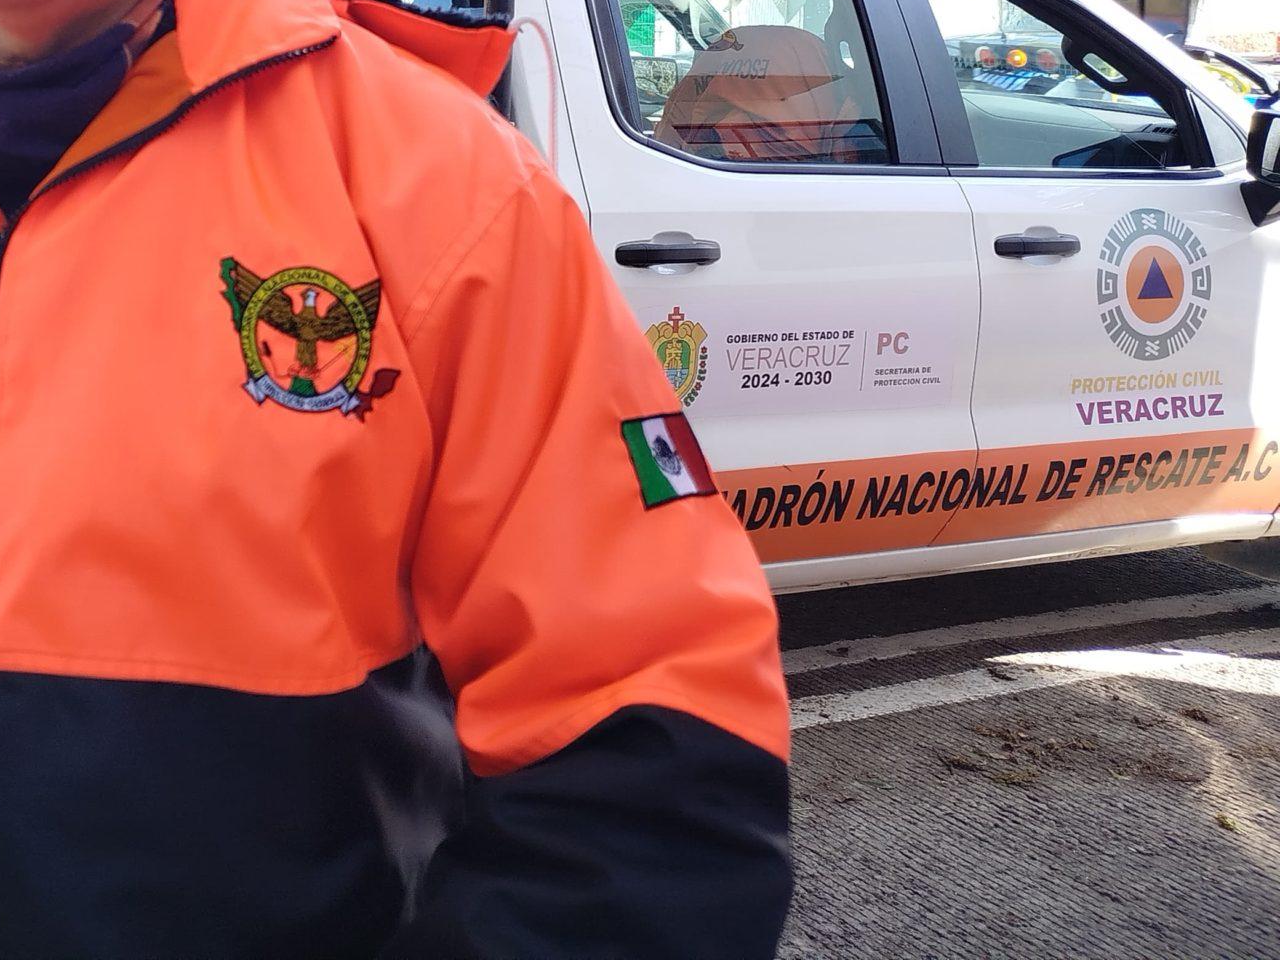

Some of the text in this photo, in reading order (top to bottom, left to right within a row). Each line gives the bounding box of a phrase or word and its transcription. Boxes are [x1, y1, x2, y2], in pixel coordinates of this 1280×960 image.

[726, 329, 855, 344] GOBIERNO DEL ESTADO DE
[876, 331, 910, 356] PC
[725, 343, 852, 372] VERACRUZ
[921, 366, 932, 374] DE
[740, 372, 780, 390] 2024
[793, 370, 832, 387] 2030
[922, 376, 942, 385] CIVIL
[1070, 369, 1224, 395] PROTECCIÓN CIVIL
[1075, 393, 1225, 426] VERACRUZ
[856, 464, 1029, 521] NACIONAL
[1035, 457, 1088, 503] DE
[1085, 445, 1228, 498] RESCATE
